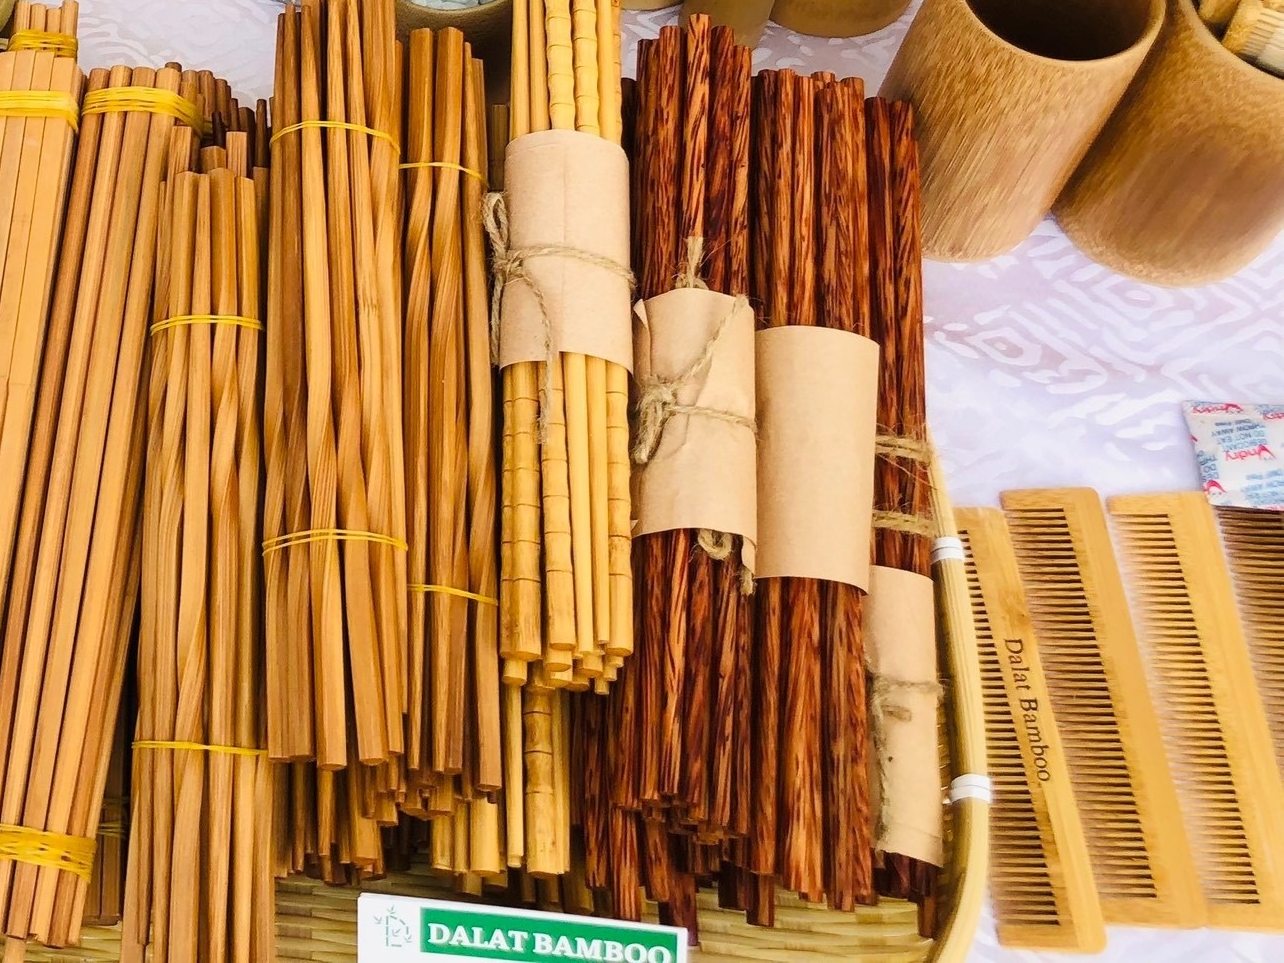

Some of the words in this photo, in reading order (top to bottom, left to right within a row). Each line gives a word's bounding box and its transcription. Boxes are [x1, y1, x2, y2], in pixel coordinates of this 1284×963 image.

[1004, 638, 1031, 691] Dalat
[1019, 697, 1052, 782] Bamboo
[427, 922, 529, 952] DALAT
[532, 931, 673, 963] BAMBOO
